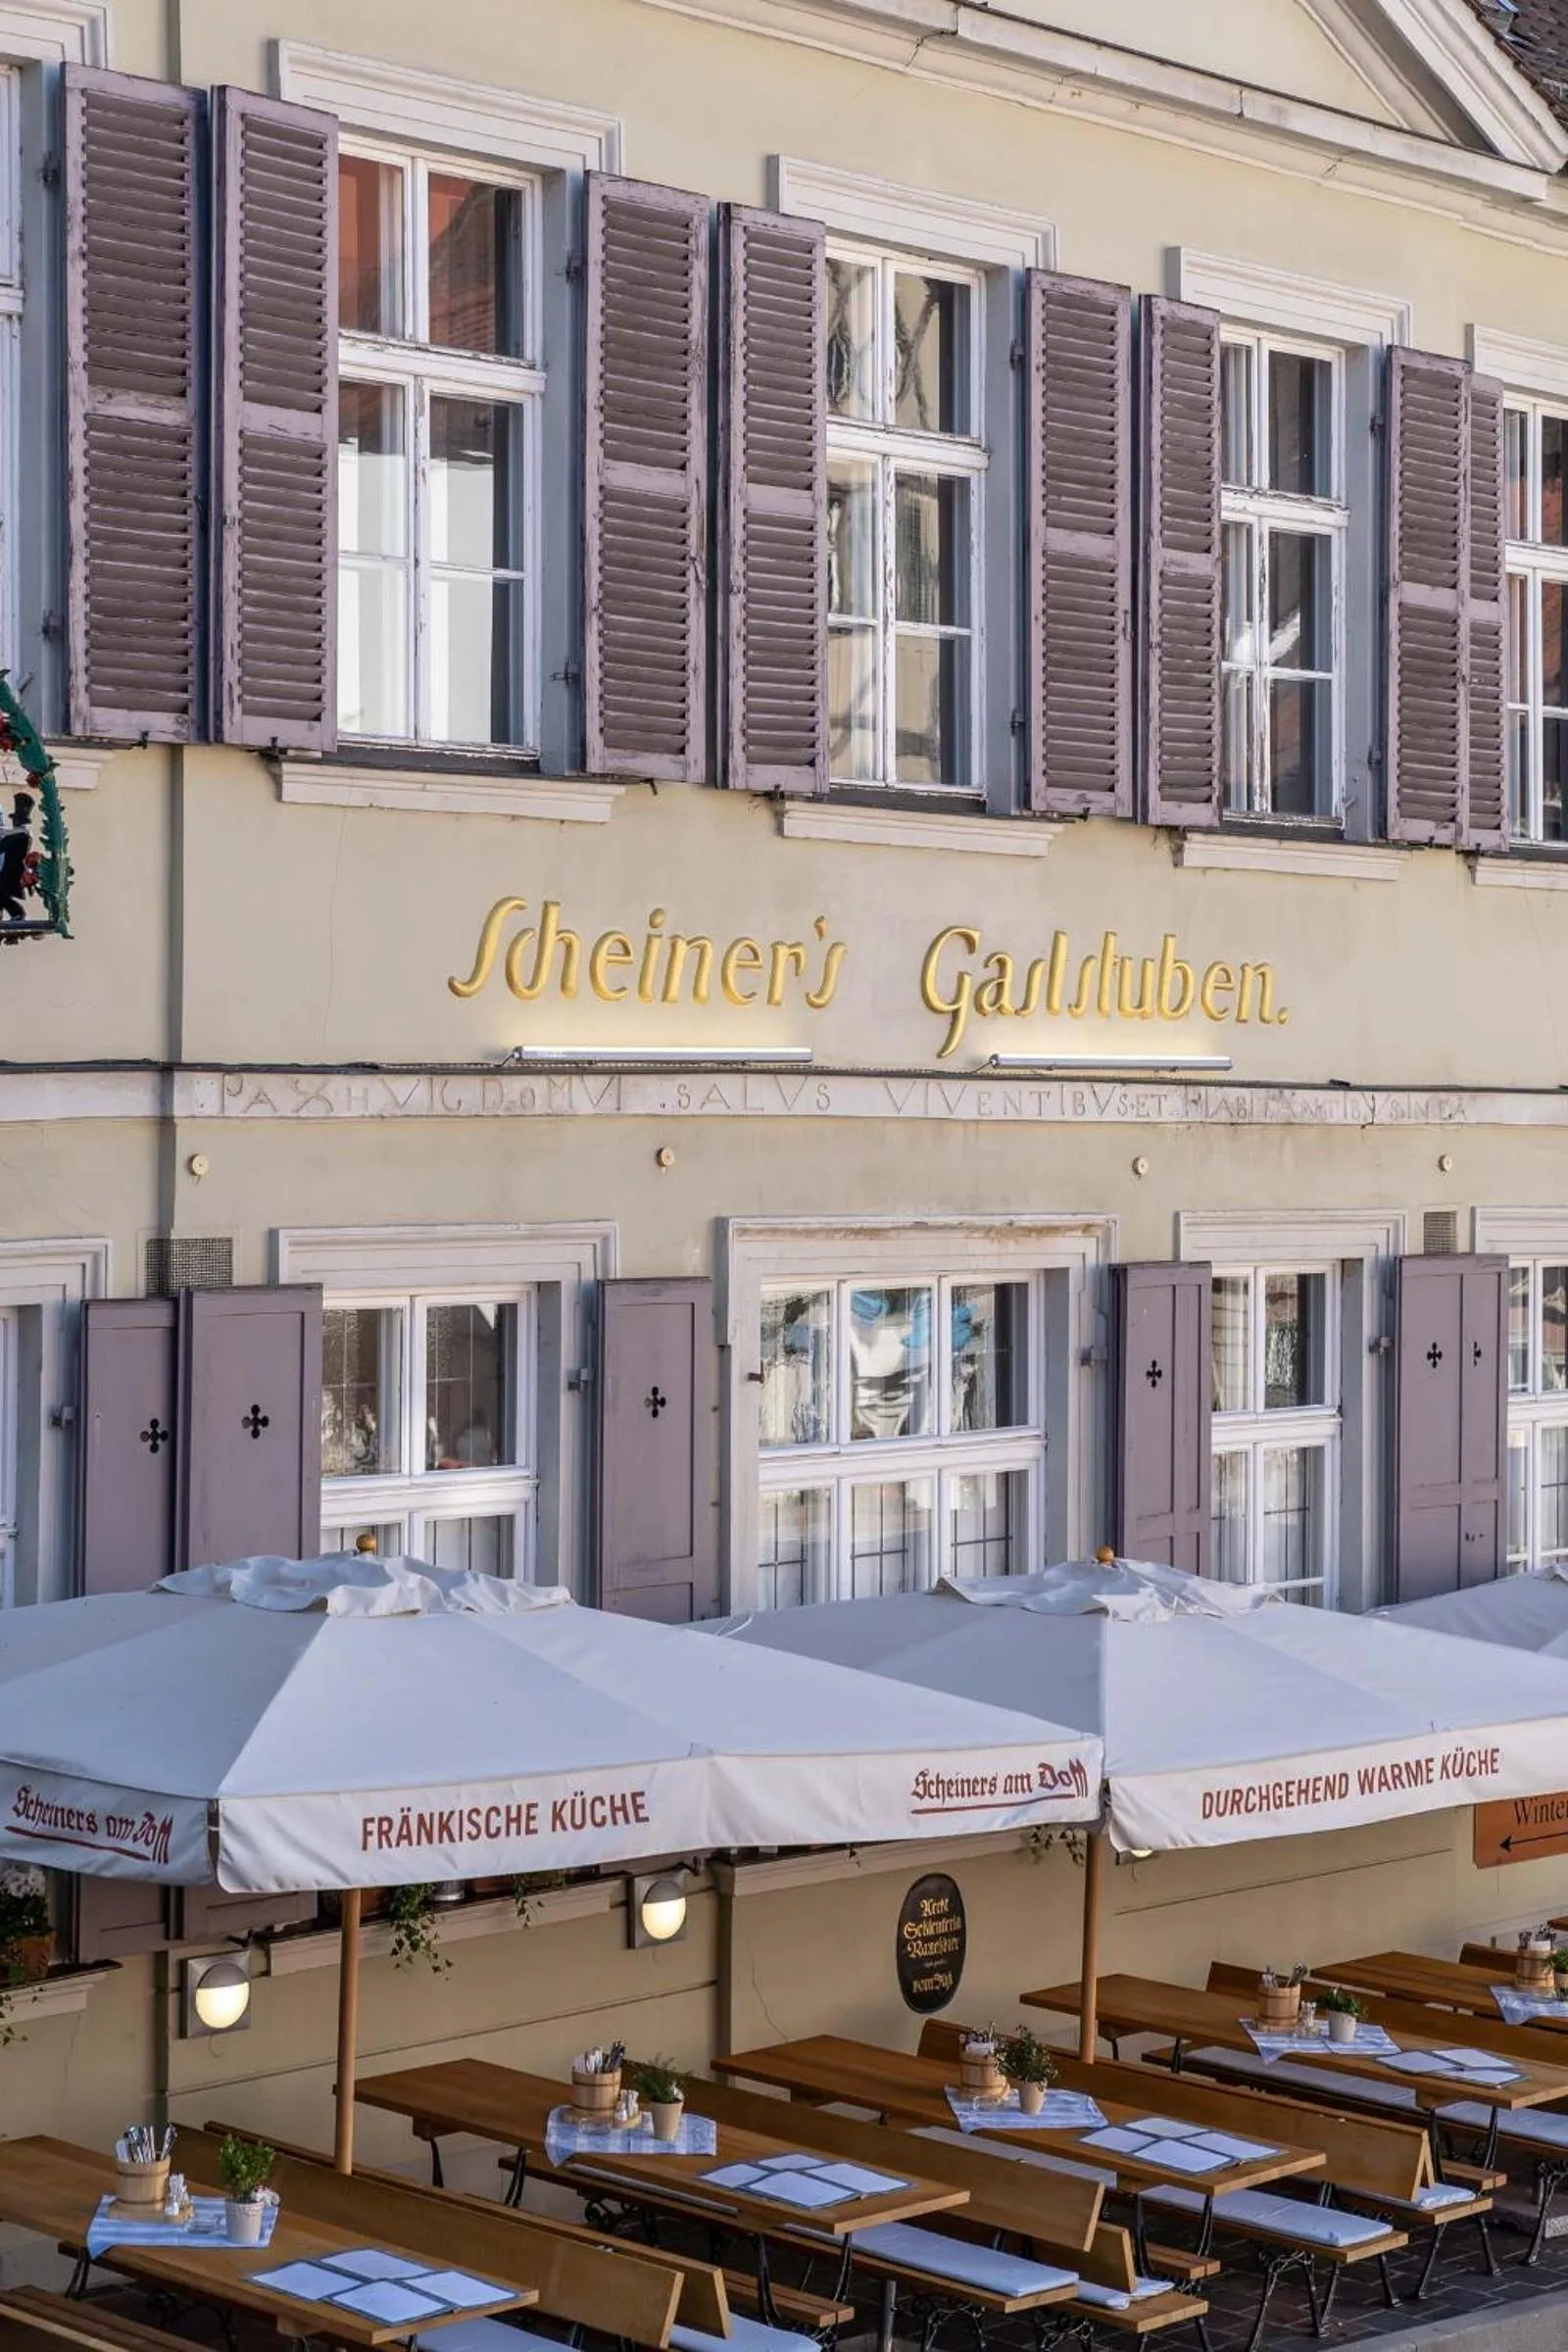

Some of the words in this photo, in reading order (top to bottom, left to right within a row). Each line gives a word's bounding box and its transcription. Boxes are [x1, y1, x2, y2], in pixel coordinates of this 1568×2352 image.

[1004, 1772, 1033, 1794] am
[1201, 1772, 1349, 1820] DURCHGEHEND
[1356, 1757, 1435, 1796] WARME
[1440, 1746, 1500, 1782] KÜCHE
[105, 1815, 135, 1841] am
[361, 1802, 539, 1851] FRÄNKISCHE
[551, 1790, 651, 1833] KÜCHE
